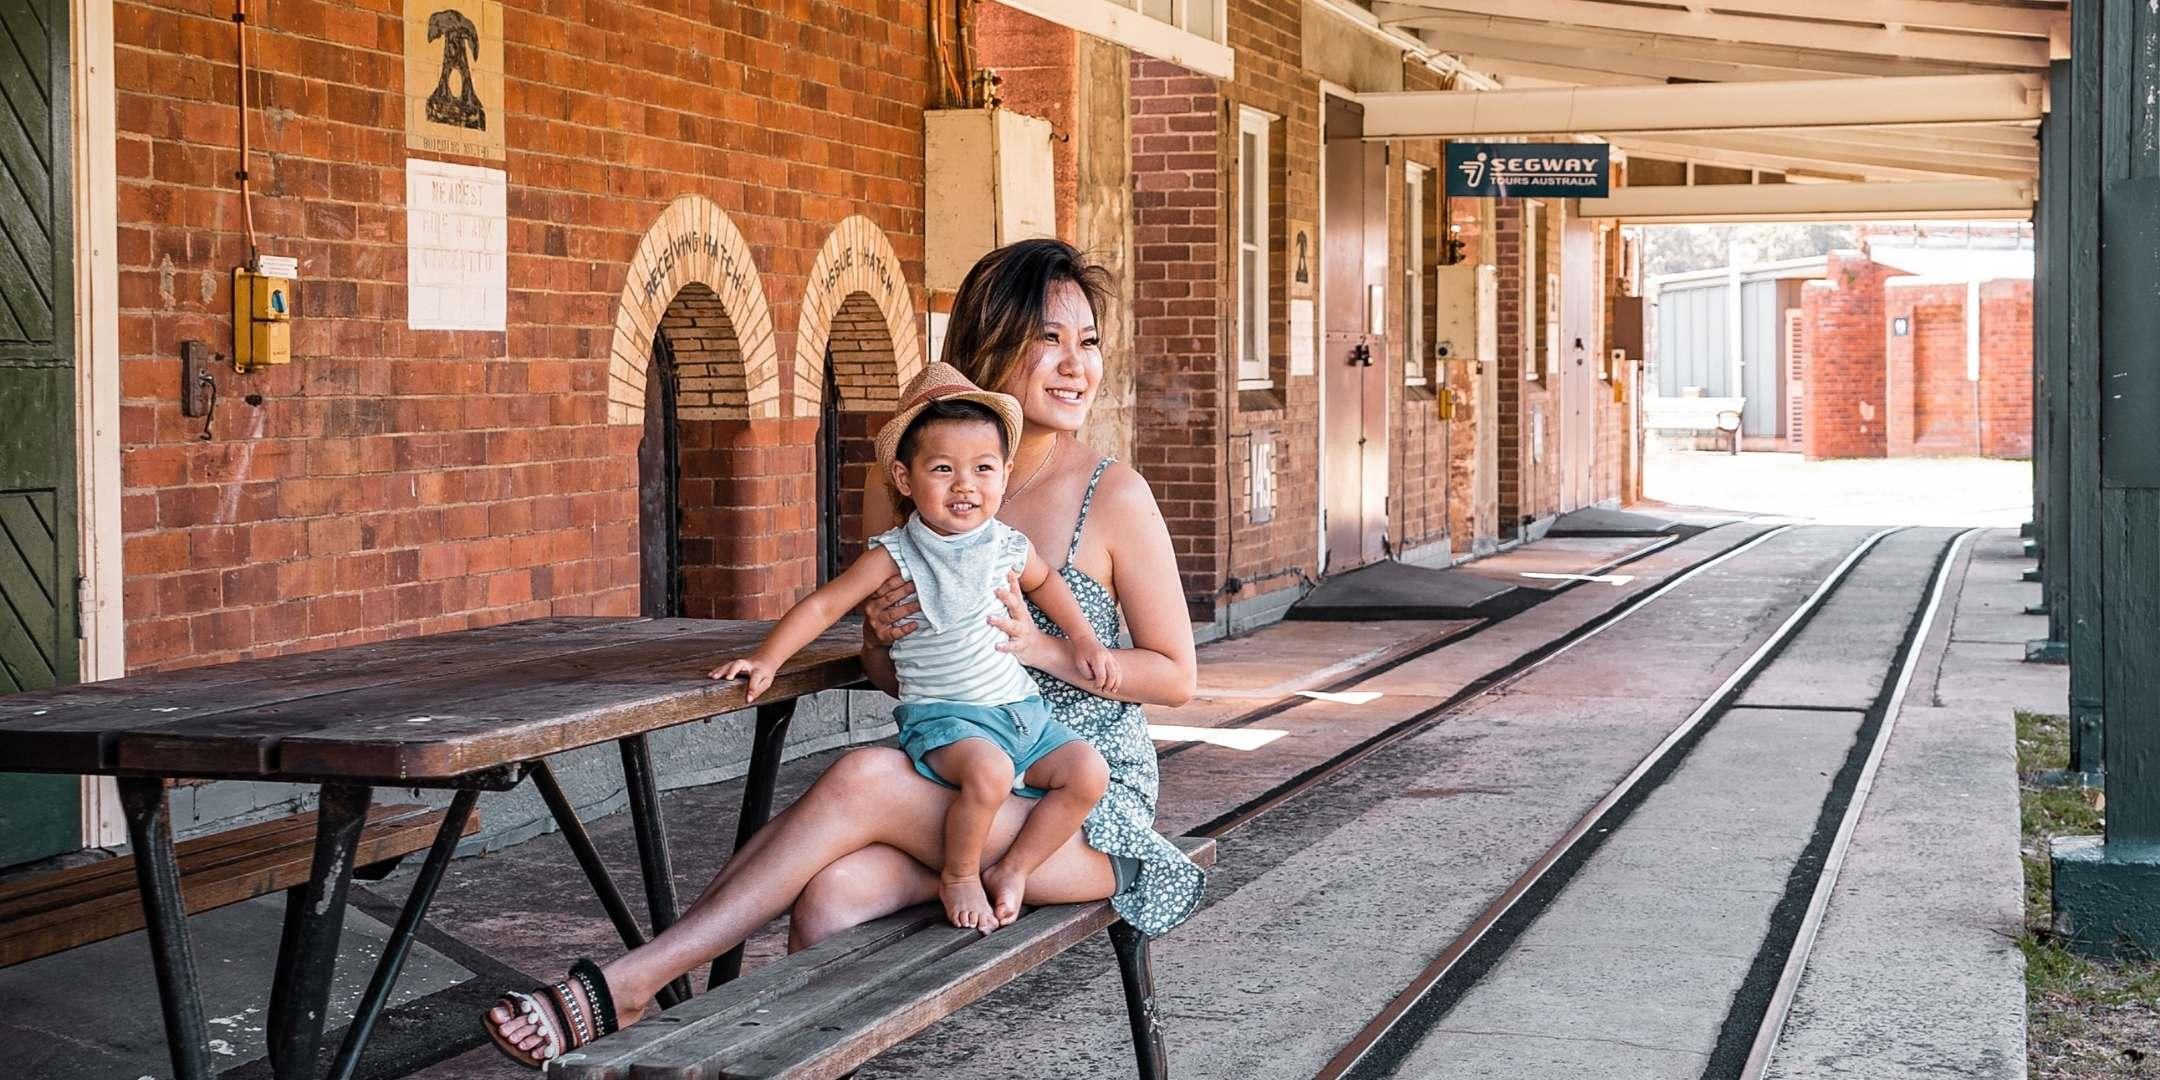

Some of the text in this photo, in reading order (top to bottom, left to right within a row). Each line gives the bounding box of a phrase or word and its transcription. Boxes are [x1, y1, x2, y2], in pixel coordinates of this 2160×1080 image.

[1490, 158, 1598, 171] SEGWAY
[431, 180, 483, 207] NEAREST
[1490, 177, 1597, 186] TOURS AUSTRALIA
[645, 231, 742, 302] RECEIVING HATCH
[825, 246, 894, 297] ISSUE HATCH
